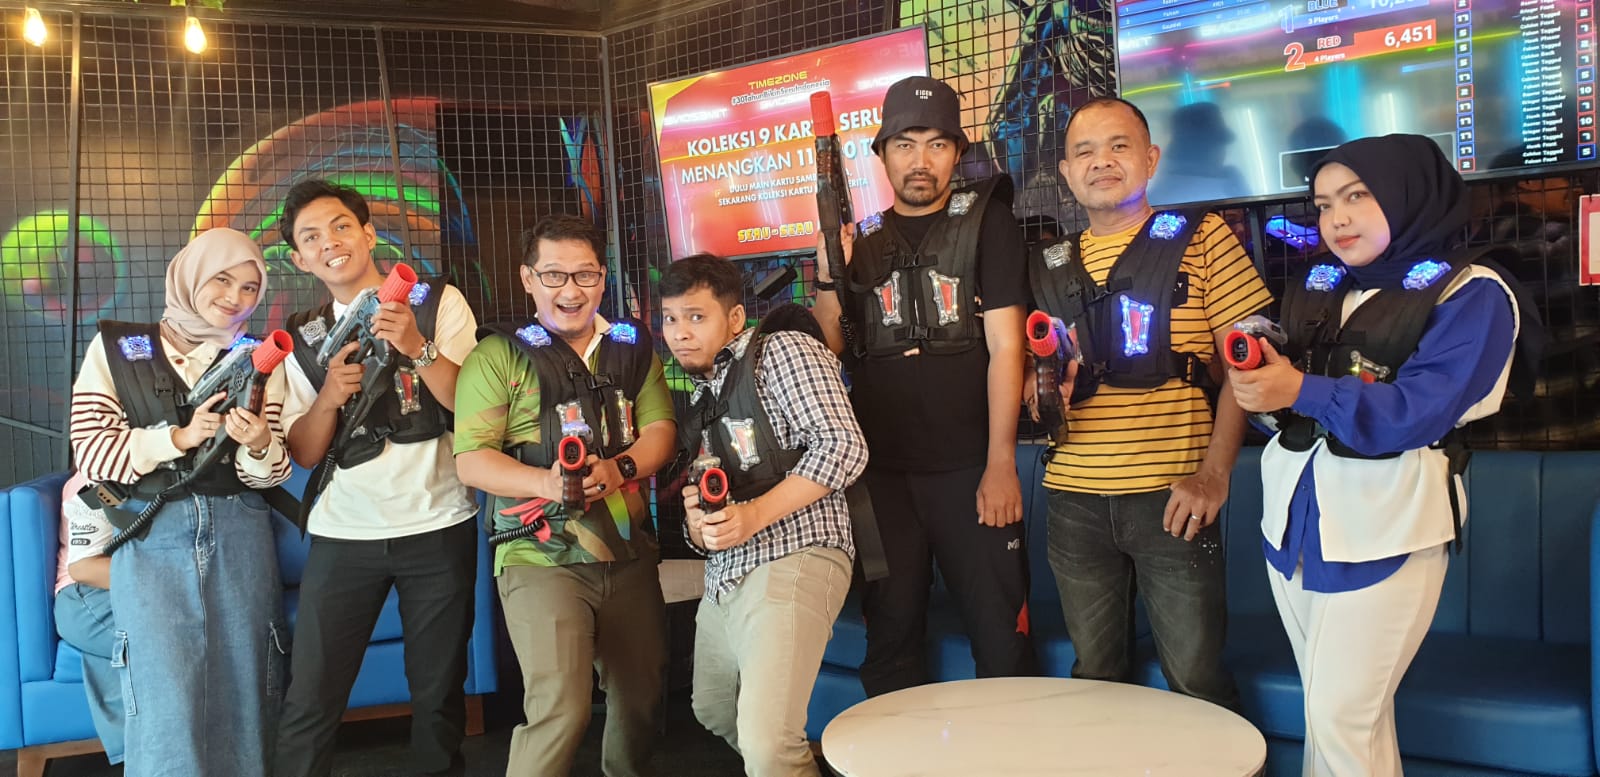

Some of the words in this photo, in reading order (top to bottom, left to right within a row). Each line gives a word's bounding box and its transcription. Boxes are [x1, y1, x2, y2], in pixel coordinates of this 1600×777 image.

[1313, 14, 1339, 24] Players
[1317, 35, 1341, 50] RED
[1384, 25, 1433, 48] 6,451
[1283, 42, 1306, 72] 2
[1314, 55, 1319, 63] 4
[1319, 53, 1345, 62] Players
[748, 71, 808, 90] TIMEZONE
[1580, 86, 1592, 94] 10
[1580, 117, 1593, 125] 10
[687, 131, 756, 158] KOLEKSI
[758, 128, 770, 145] 9
[1582, 148, 1591, 156] 5
[681, 151, 792, 185] MENANGKAN
[729, 184, 748, 194] DULU
[750, 182, 770, 192] MAIN
[771, 178, 795, 188] KARTU
[718, 194, 757, 207] SEKARANG
[758, 189, 788, 201] KOLEKSI
[788, 186, 813, 196] KARTU
